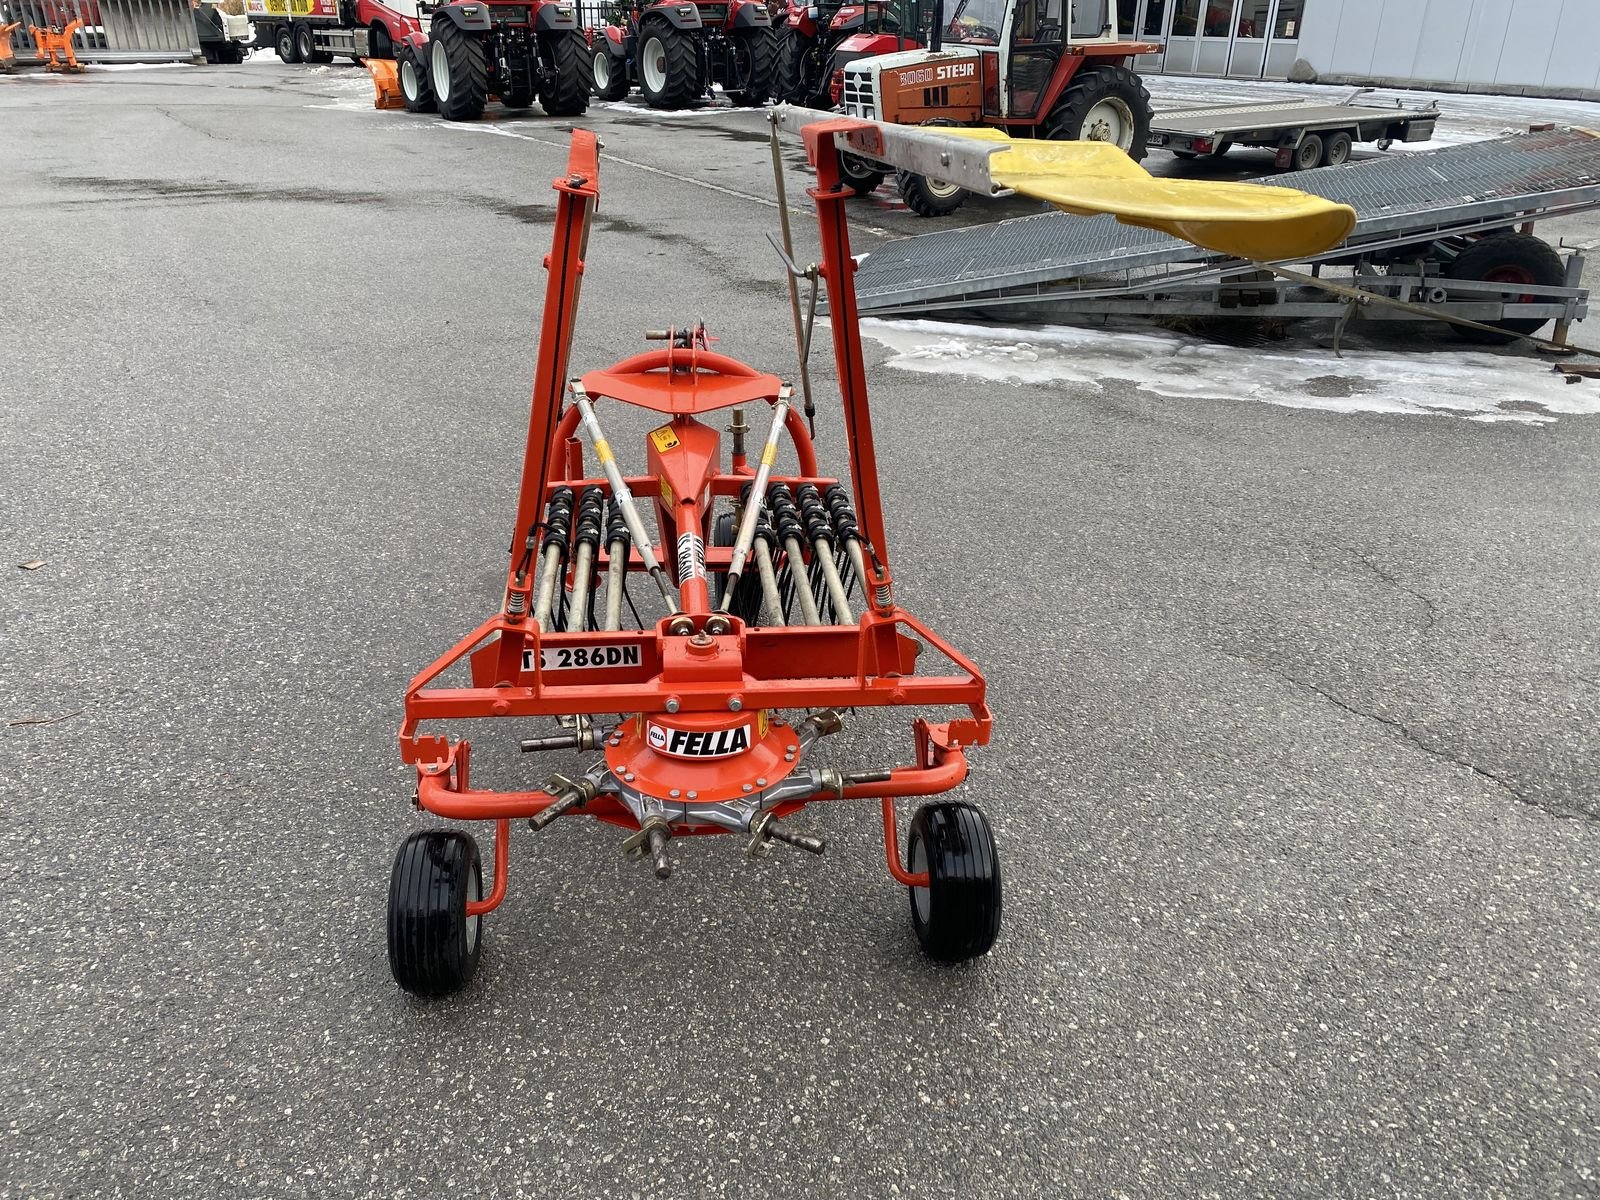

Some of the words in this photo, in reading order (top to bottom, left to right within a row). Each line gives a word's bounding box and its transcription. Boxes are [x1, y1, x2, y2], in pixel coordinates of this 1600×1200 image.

[937, 63, 974, 80] STEYR
[557, 646, 639, 667] 286DN
[650, 731, 665, 742] FELLA
[668, 726, 749, 756] FELLA
